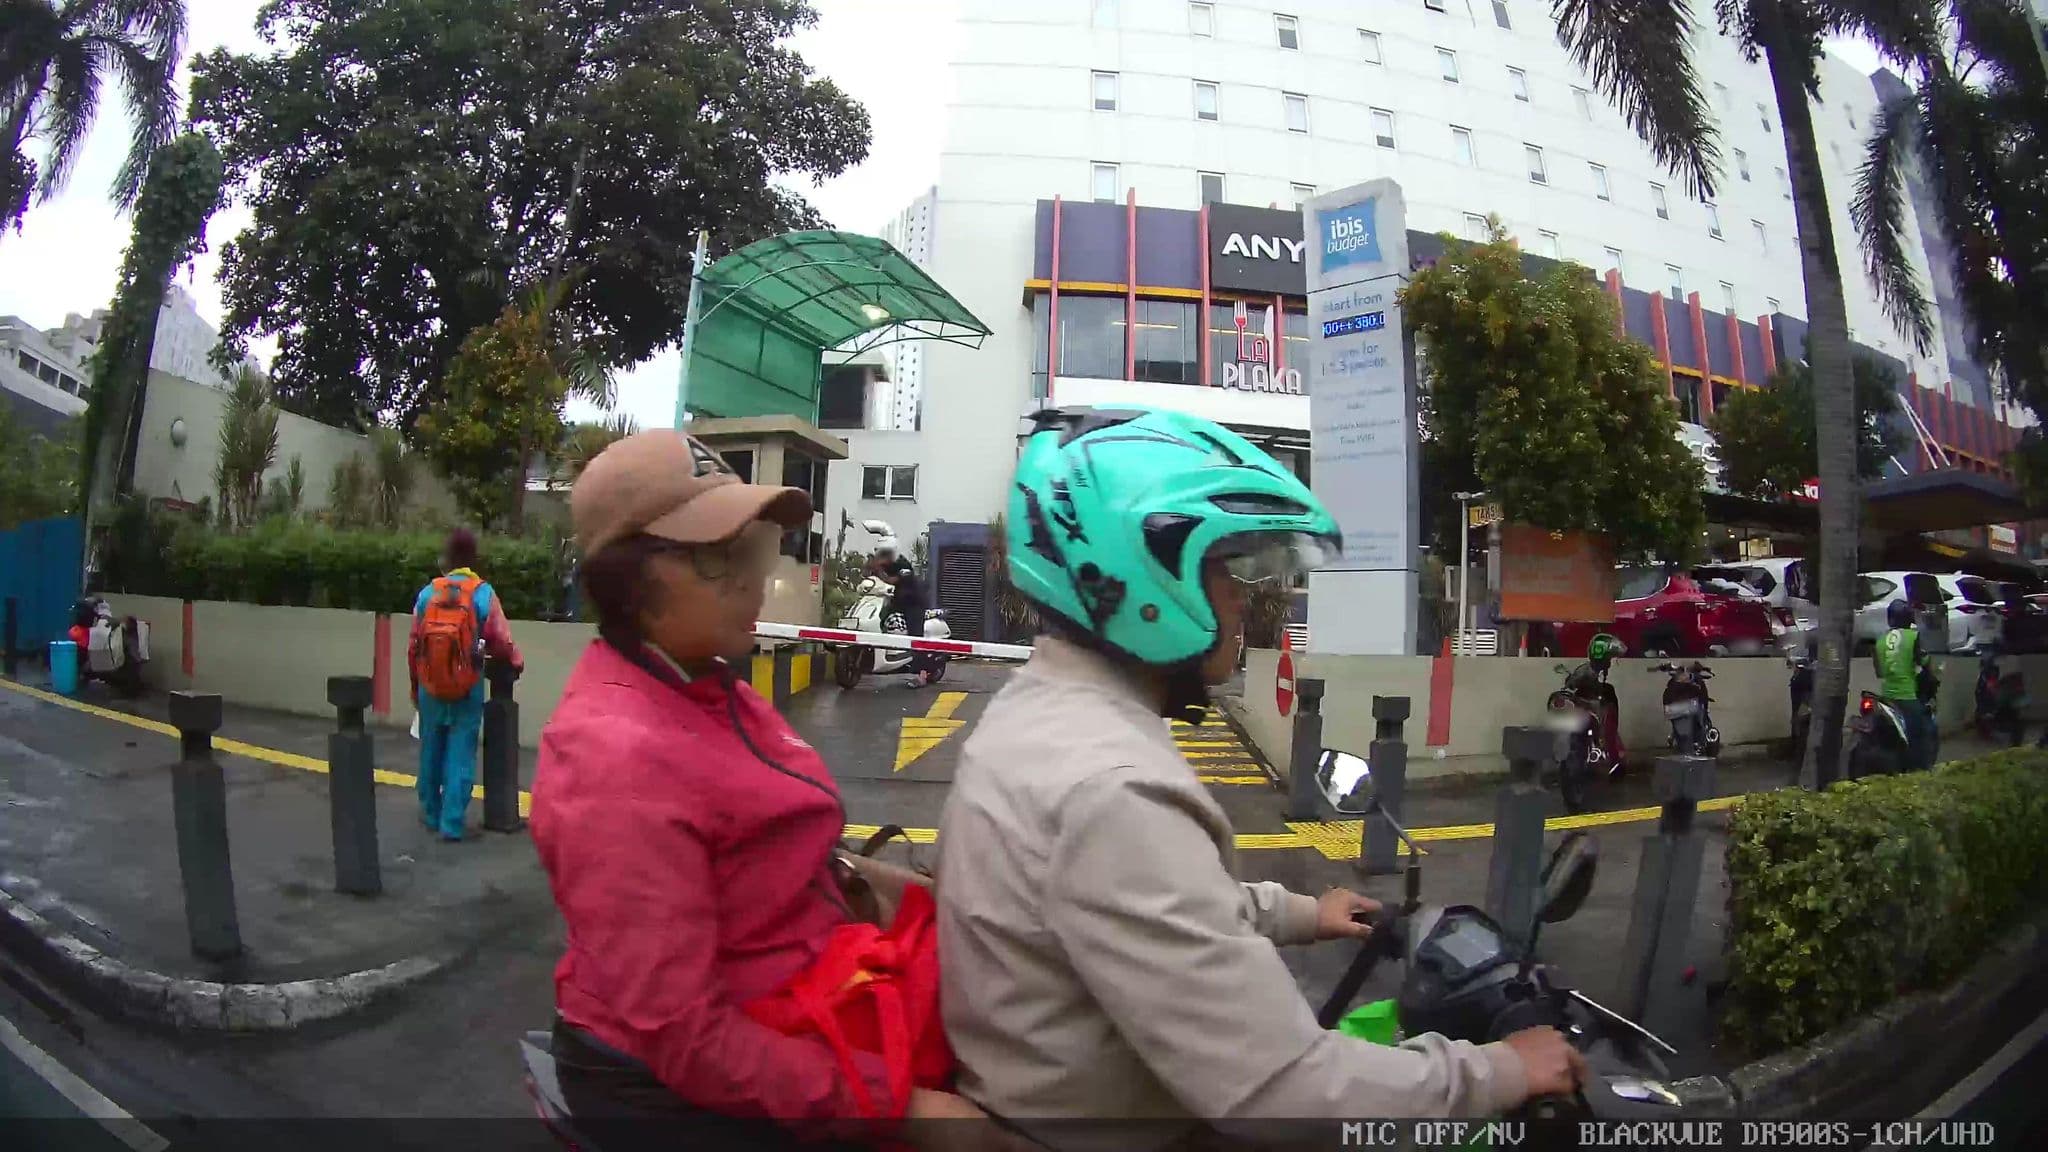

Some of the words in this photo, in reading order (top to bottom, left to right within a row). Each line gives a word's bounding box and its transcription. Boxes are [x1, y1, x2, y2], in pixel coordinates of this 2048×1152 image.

[1331, 216, 1364, 240] ibis
[1327, 232, 1370, 254] budget
[1323, 299, 1351, 312] tart
[1237, 334, 1269, 362] LA
[1222, 361, 1302, 394] PLAKA
